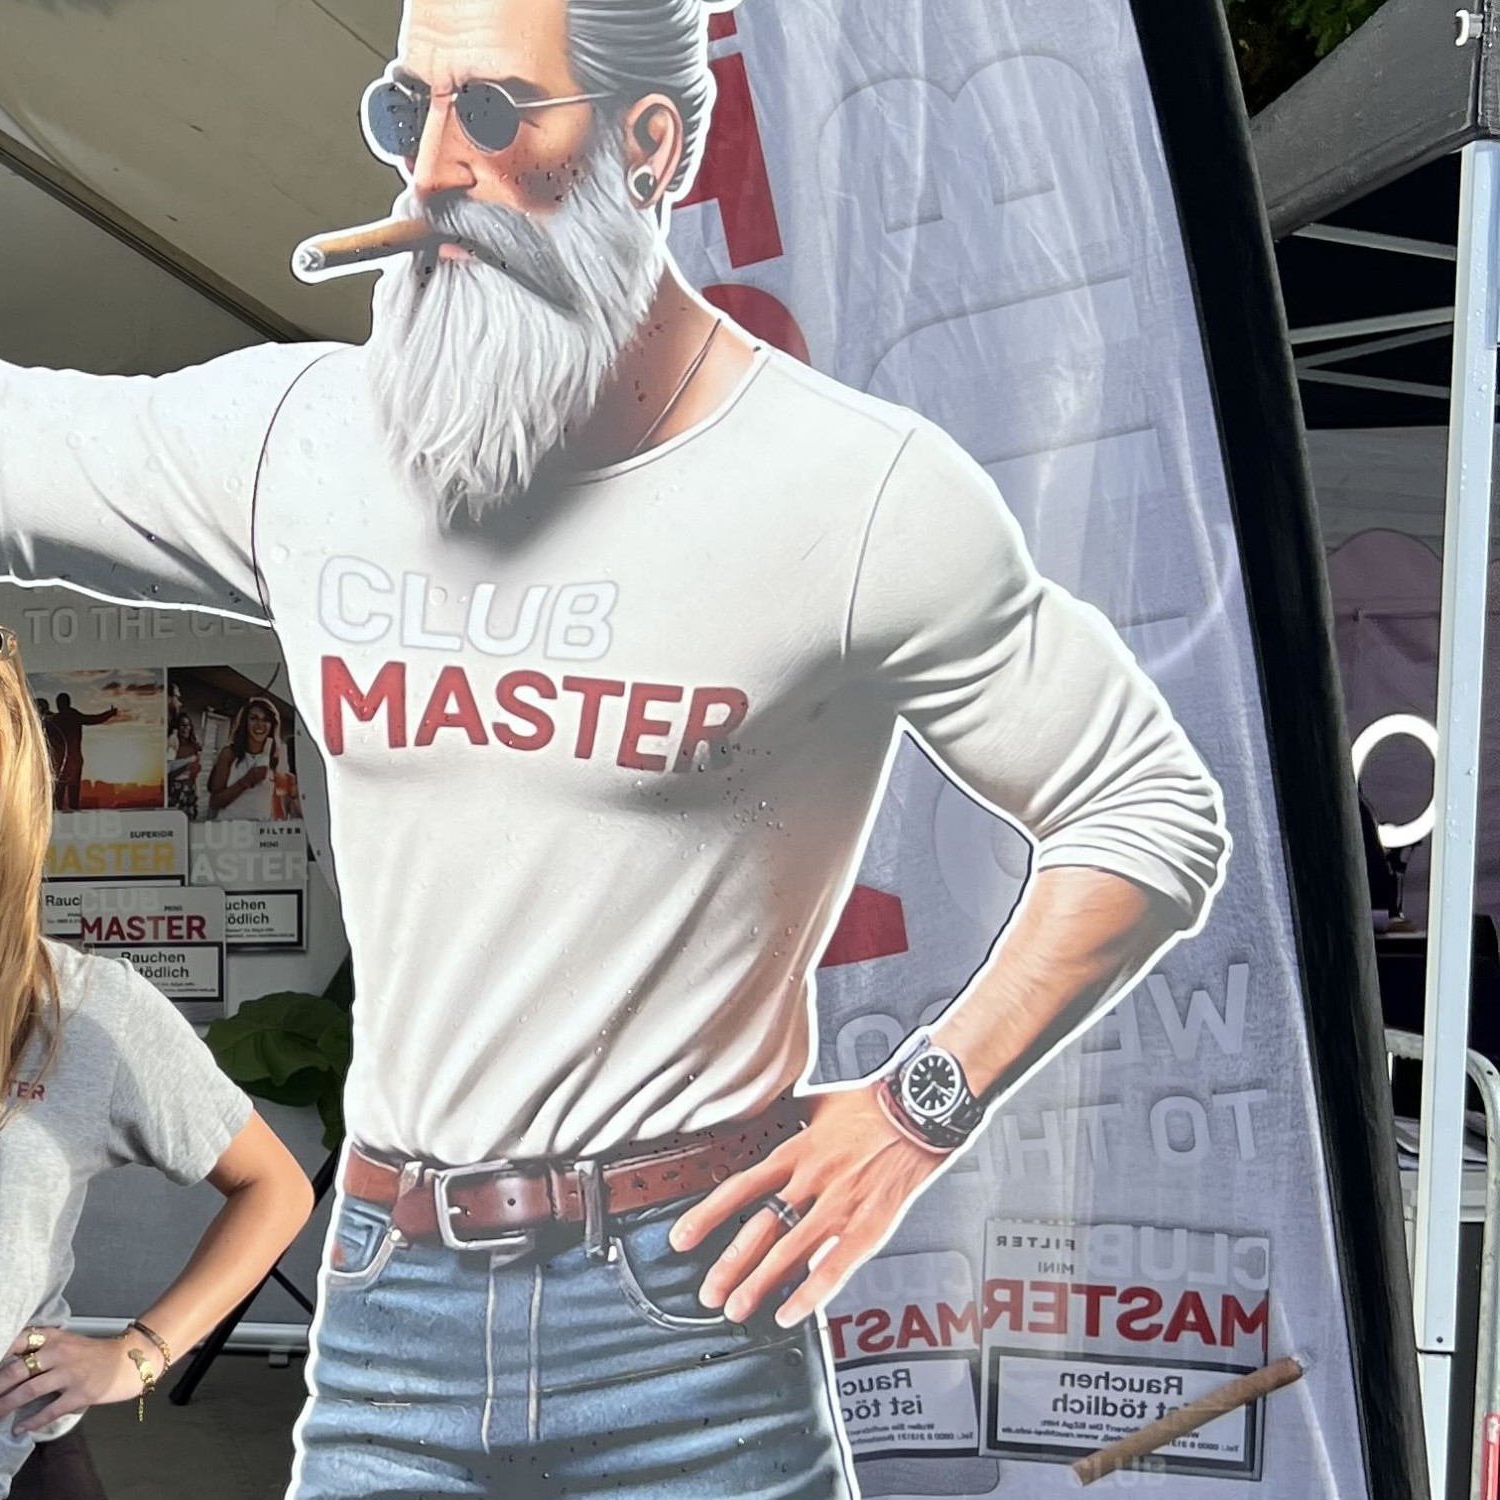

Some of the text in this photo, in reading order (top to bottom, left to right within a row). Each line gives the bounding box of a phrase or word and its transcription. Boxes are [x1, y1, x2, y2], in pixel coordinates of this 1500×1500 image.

[317, 554, 620, 663] CLUB
[320, 654, 750, 775] MASTER
[259, 827, 301, 835] FILTER
[191, 851, 308, 883] ASTER
[45, 895, 83, 907] Rauc
[225, 899, 266, 911] uchen
[81, 914, 207, 941] MASTER
[226, 913, 270, 925] ödlich
